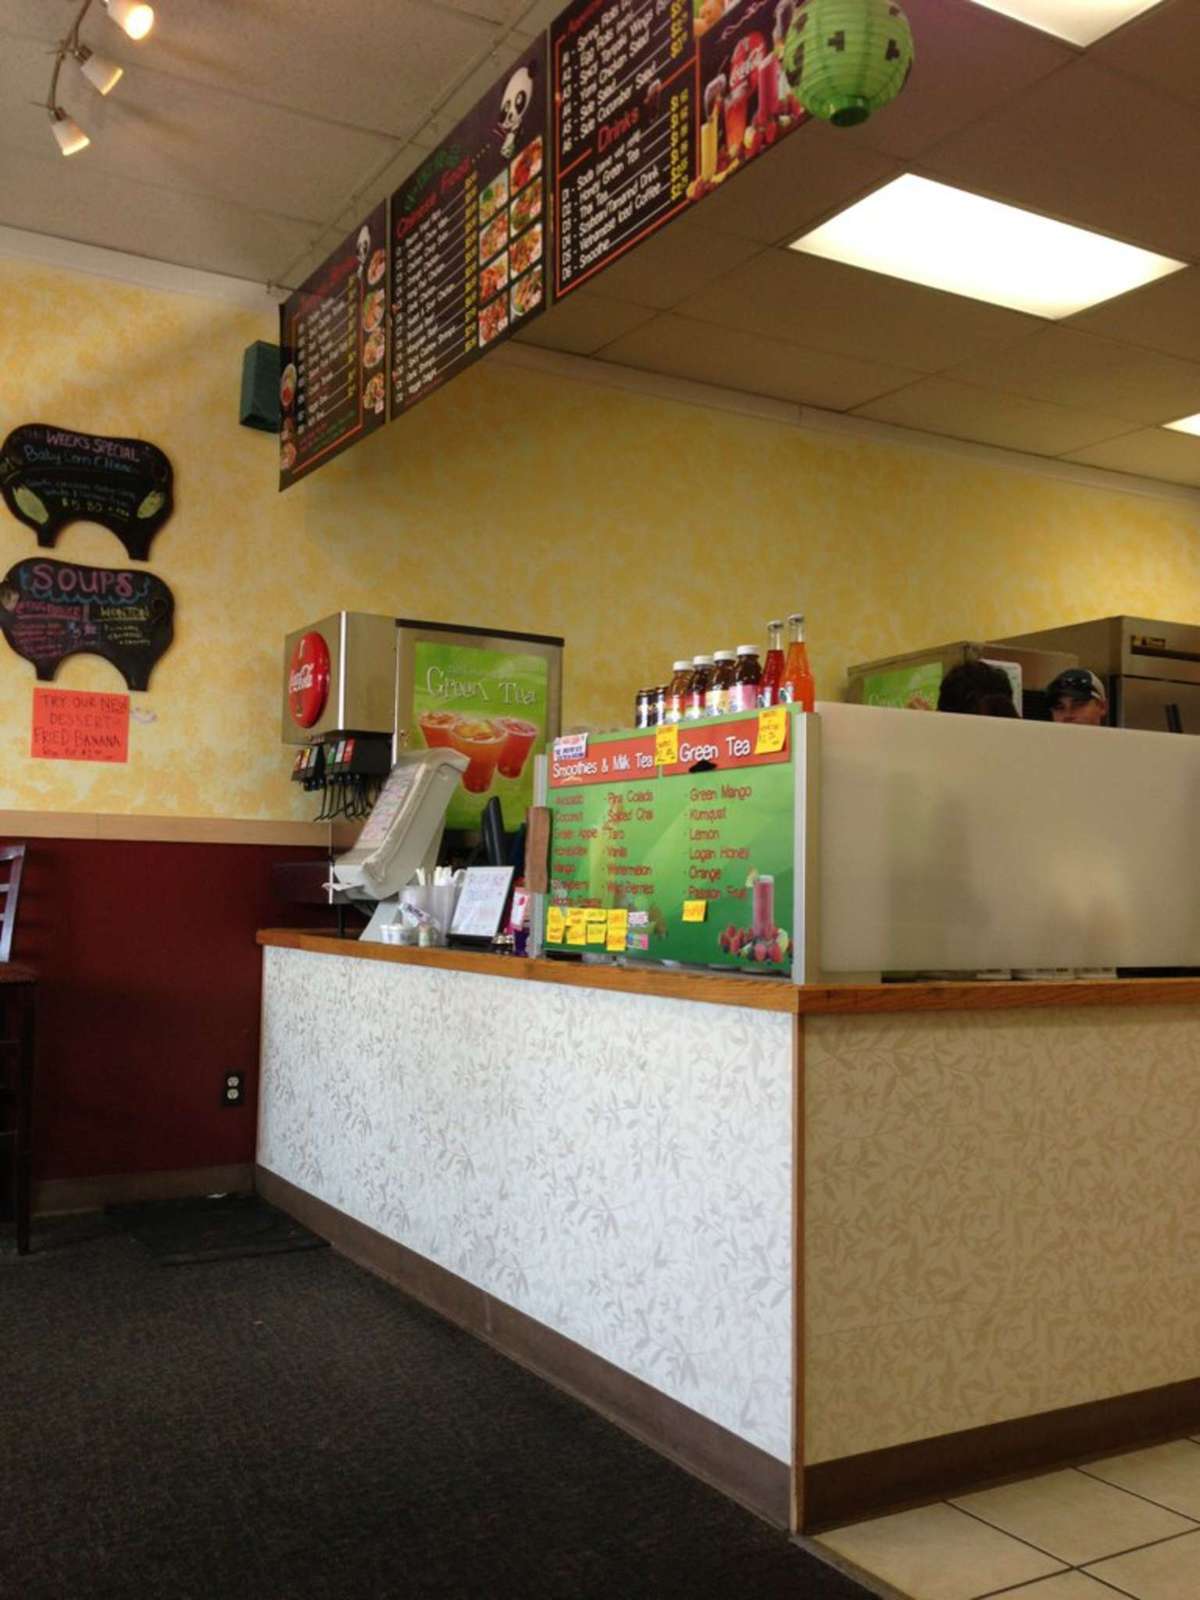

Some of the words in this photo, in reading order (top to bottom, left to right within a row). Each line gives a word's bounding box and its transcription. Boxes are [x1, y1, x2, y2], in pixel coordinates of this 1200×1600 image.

[598, 107, 639, 152] Drinks
[92, 438, 140, 463] SPECIAL
[32, 563, 134, 597] SOUPS
[427, 666, 489, 703] Green
[499, 682, 537, 705] Tea
[680, 743, 719, 762] Green
[726, 736, 751, 756] Tea
[553, 760, 597, 778] Smoothies
[601, 756, 609, 772] &
[635, 753, 653, 769] Tea
[690, 788, 717, 801] Green
[721, 784, 752, 800] Mango
[689, 829, 719, 840] Lemon
[689, 865, 721, 882] Orange
